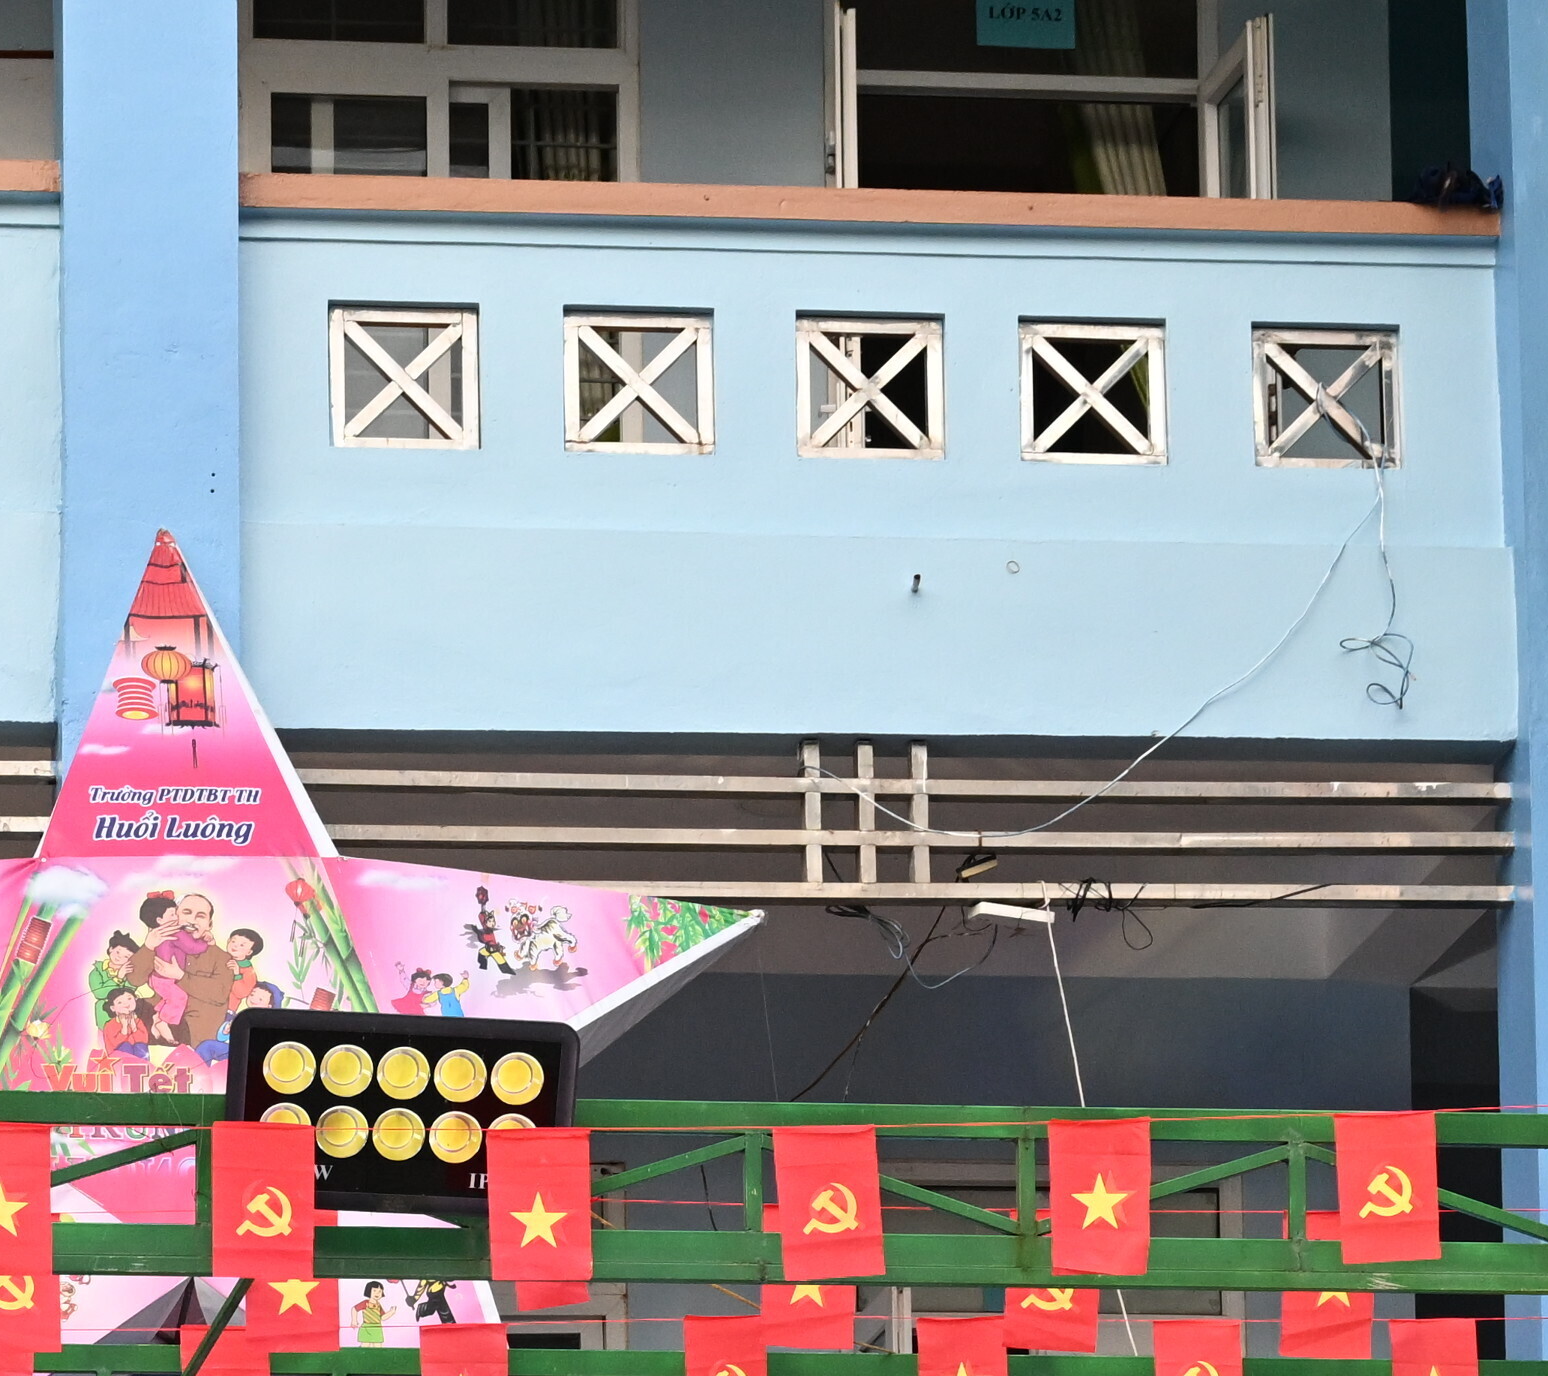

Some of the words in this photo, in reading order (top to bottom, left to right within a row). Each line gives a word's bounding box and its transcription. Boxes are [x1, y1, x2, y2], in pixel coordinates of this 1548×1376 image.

[989, 3, 1026, 20] LỚP
[1031, 9, 1062, 21] 5A2
[90, 786, 153, 805] Trường
[158, 788, 231, 803] PTDTBT
[236, 788, 261, 803] TH
[94, 811, 159, 840] Huổi
[165, 816, 253, 844] Luông
[42, 1056, 114, 1091] Vui
[123, 1063, 192, 1093] Tết
